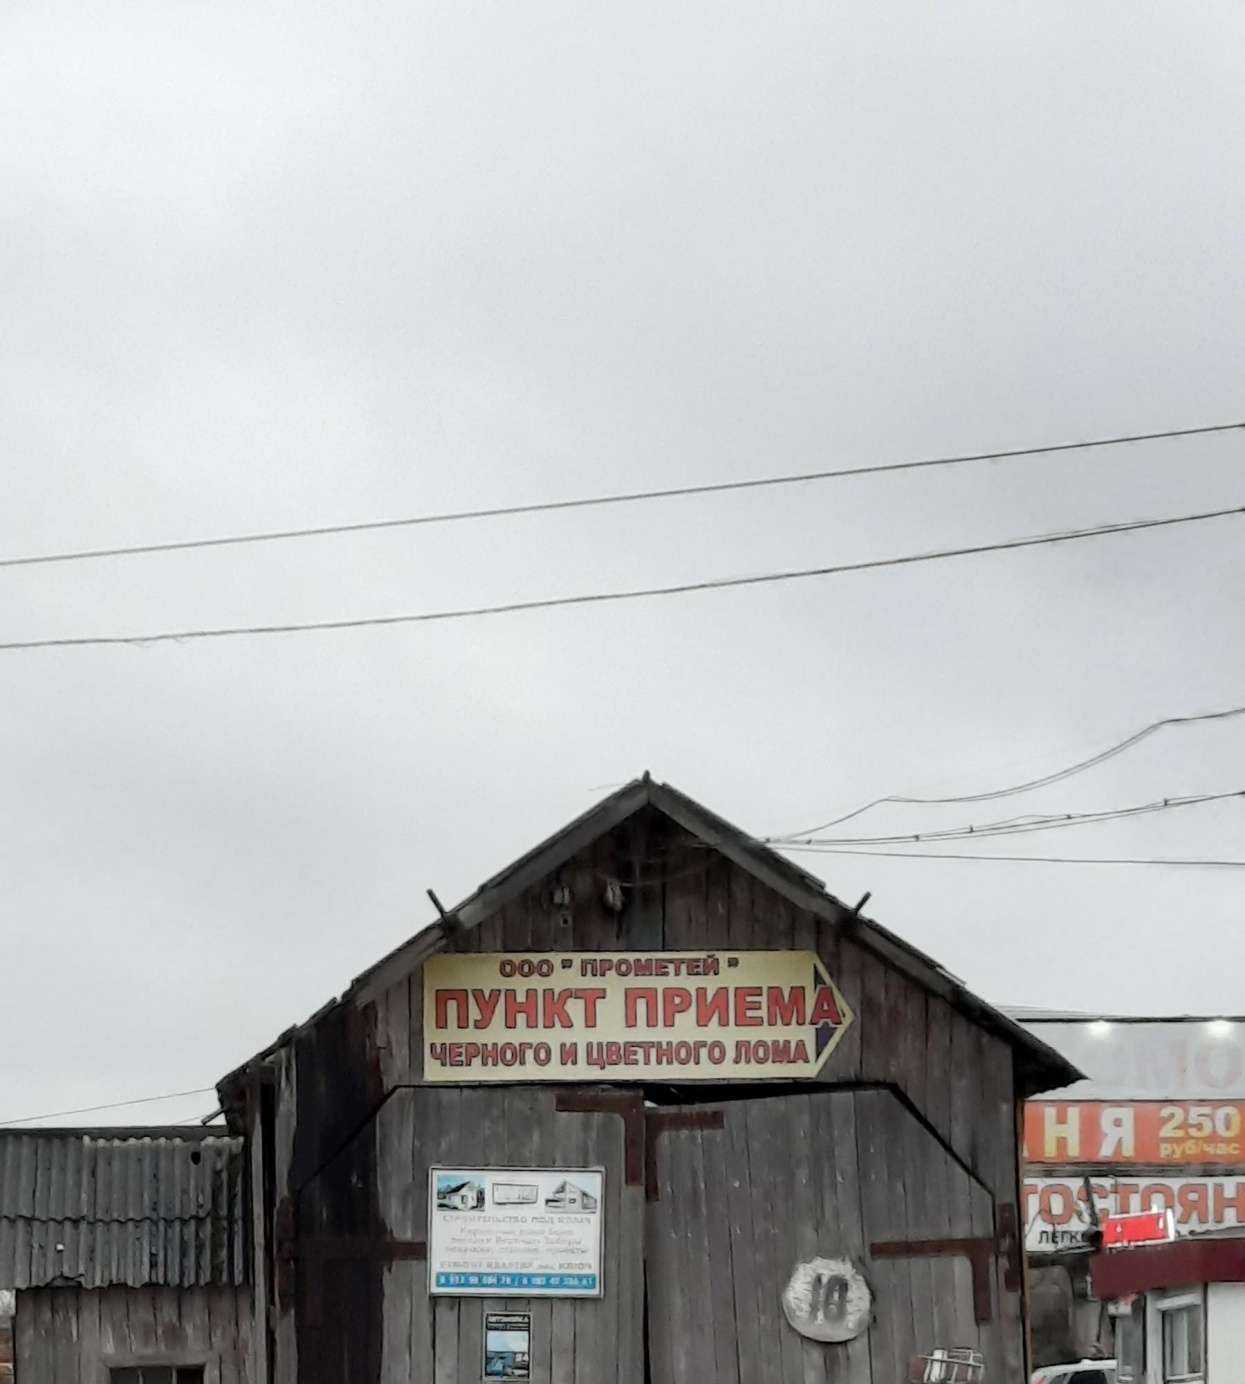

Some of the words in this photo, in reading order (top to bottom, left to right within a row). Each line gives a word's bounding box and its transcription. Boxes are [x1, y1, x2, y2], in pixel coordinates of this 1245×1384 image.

[499, 958, 554, 978] ООО
[580, 954, 720, 977] ПРОМЕТЕЙ
[434, 987, 607, 1030] ПУНКТ
[625, 984, 843, 1028] ПРИЕМА
[430, 1040, 552, 1068] ЧЕРНОГО
[559, 1041, 578, 1066] И
[585, 1040, 726, 1070] ЦВЕТНОГО
[733, 1039, 809, 1065] ЛОМА
[1023, 1106, 1135, 1159] НЯ
[1158, 1105, 1241, 1138] 250
[1159, 1139, 1241, 1159] руб/час
